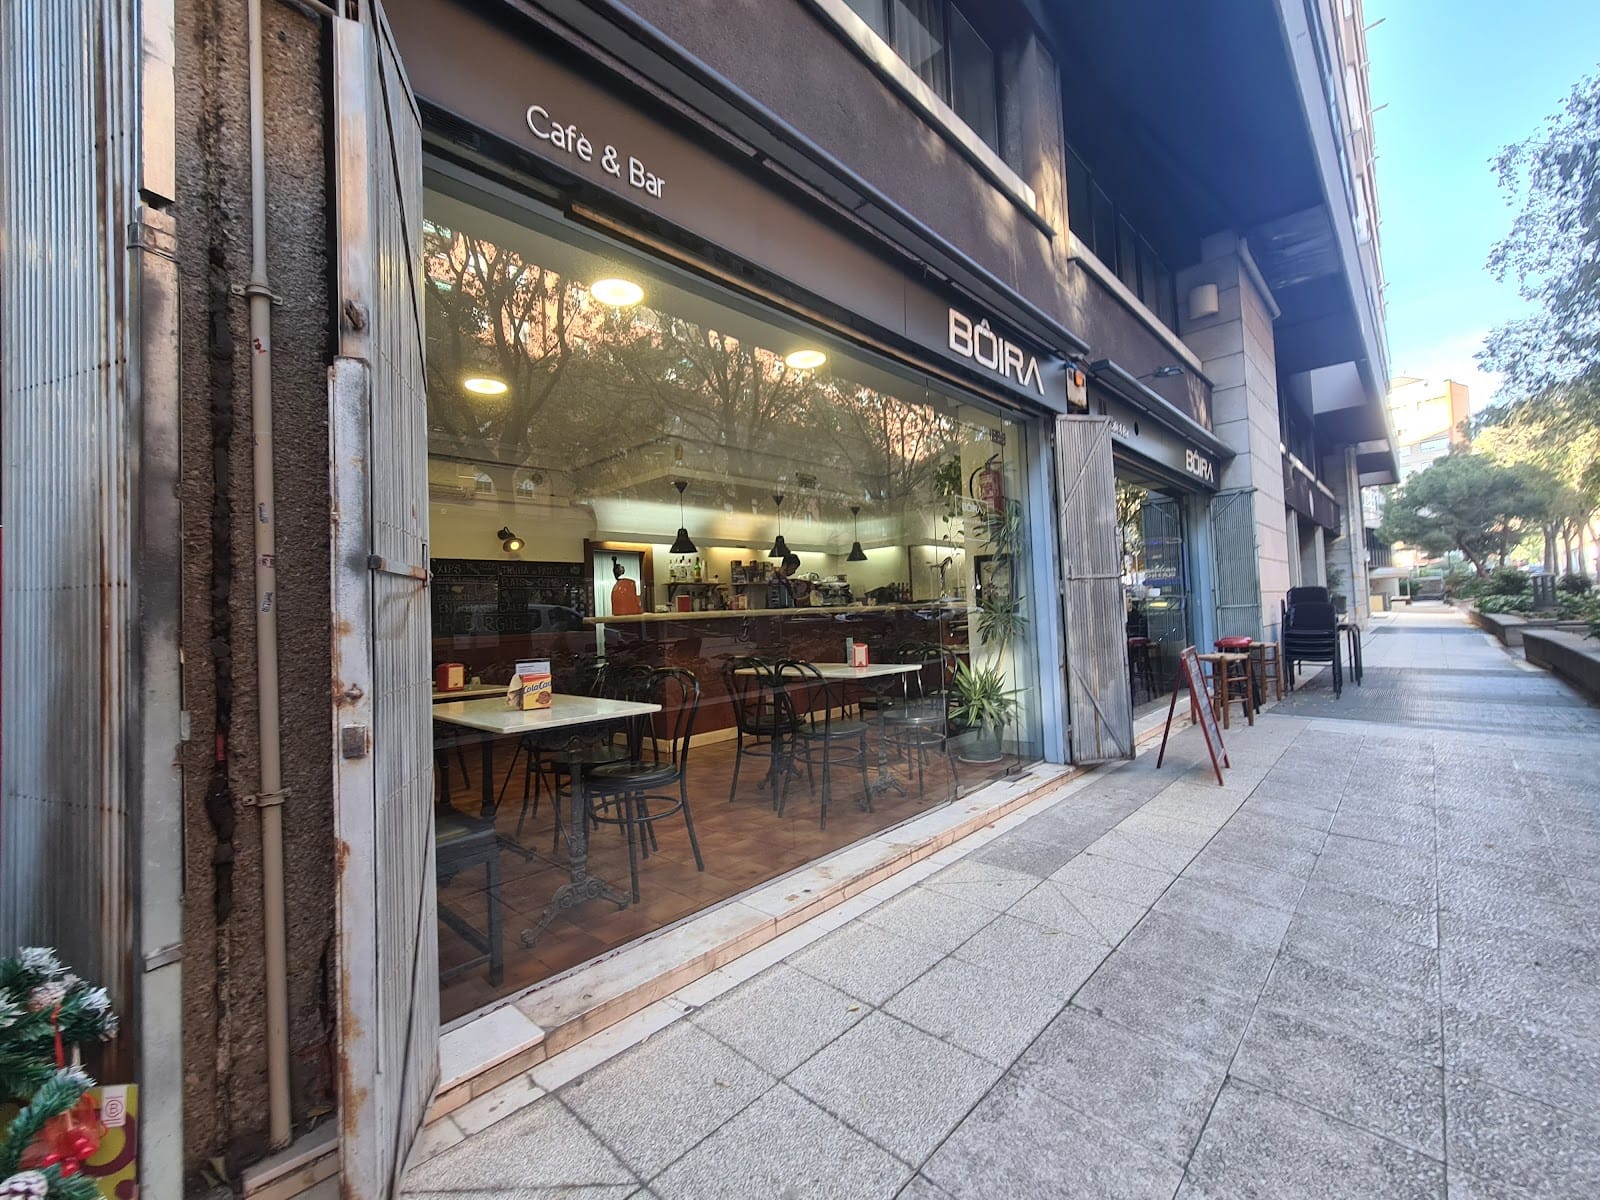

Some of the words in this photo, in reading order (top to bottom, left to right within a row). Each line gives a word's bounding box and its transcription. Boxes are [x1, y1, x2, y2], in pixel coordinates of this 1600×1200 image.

[526, 105, 593, 162] Cafè
[601, 145, 621, 177] &
[629, 156, 665, 198] Bar
[949, 308, 1044, 395] BÔIRA
